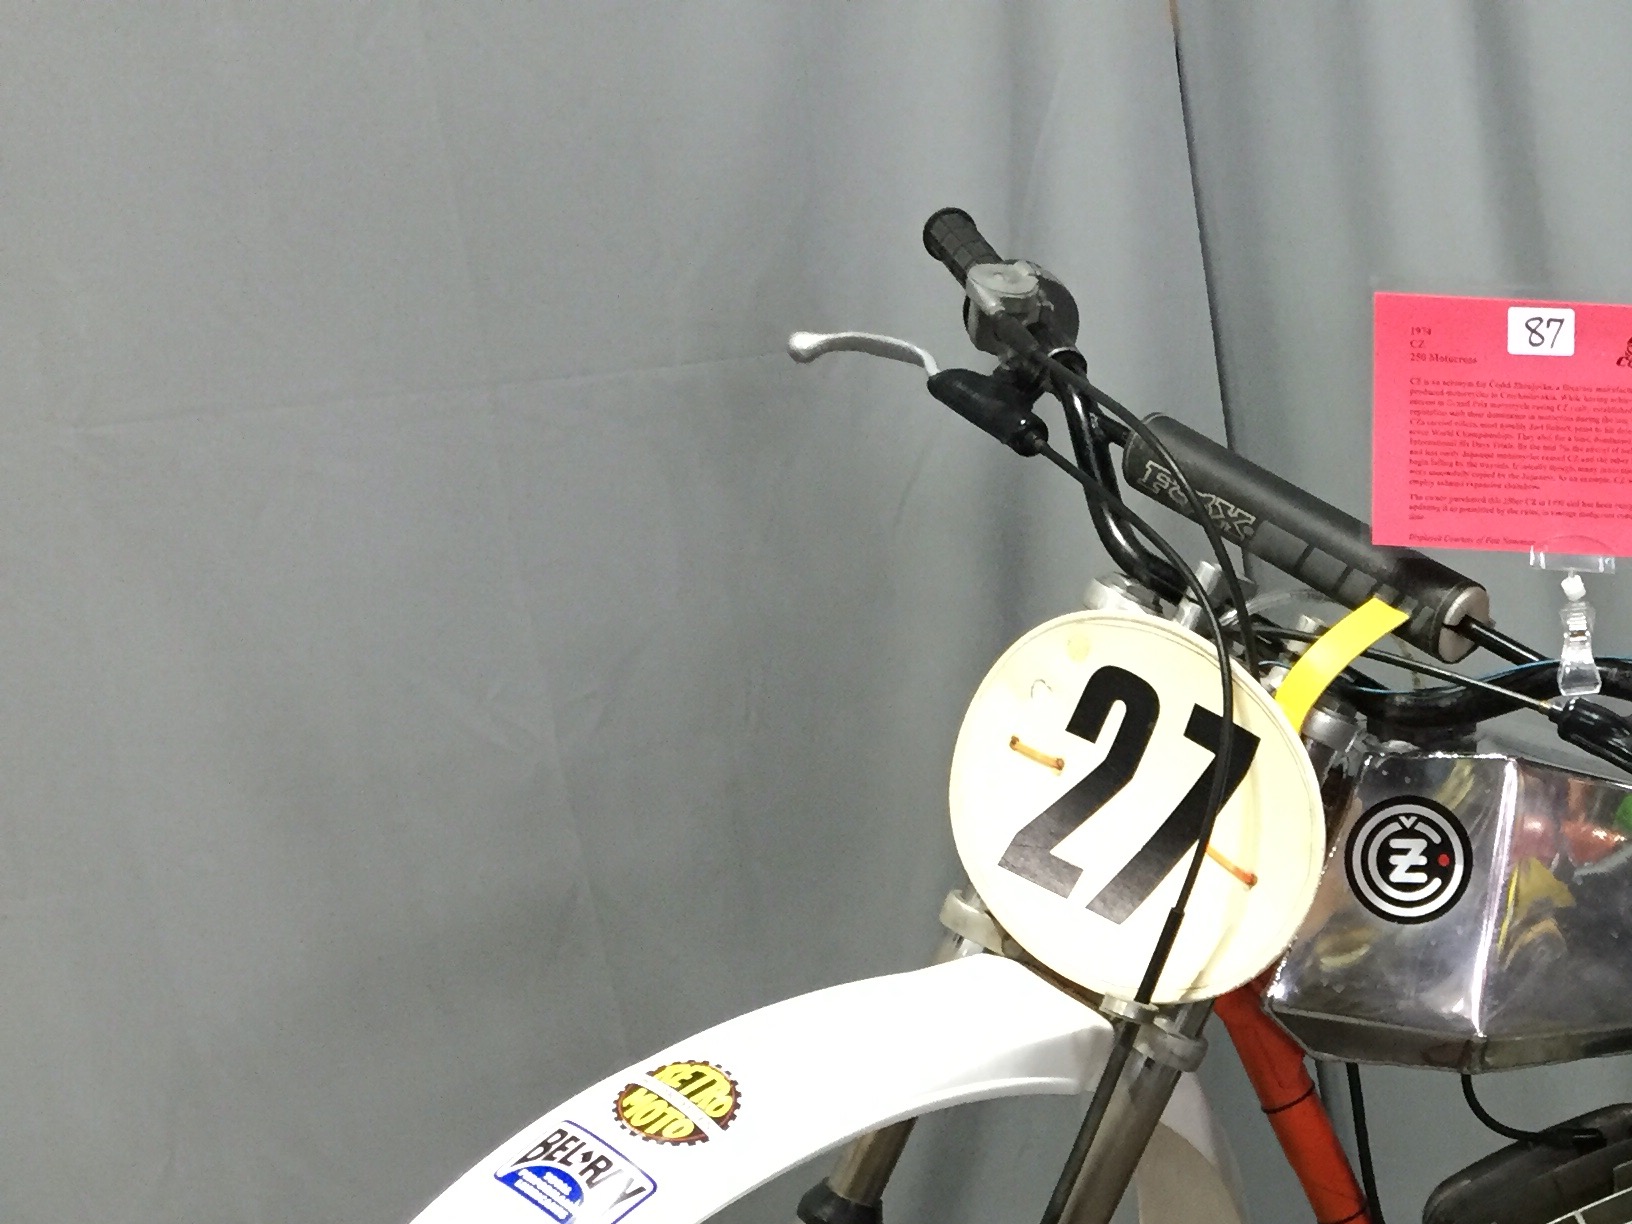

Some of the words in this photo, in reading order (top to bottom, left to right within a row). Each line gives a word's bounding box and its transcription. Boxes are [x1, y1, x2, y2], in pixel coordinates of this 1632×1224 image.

[1410, 339, 1425, 349] CZ
[1525, 316, 1565, 349] 87
[998, 664, 1261, 925] 27
[622, 1087, 696, 1138] MOTO
